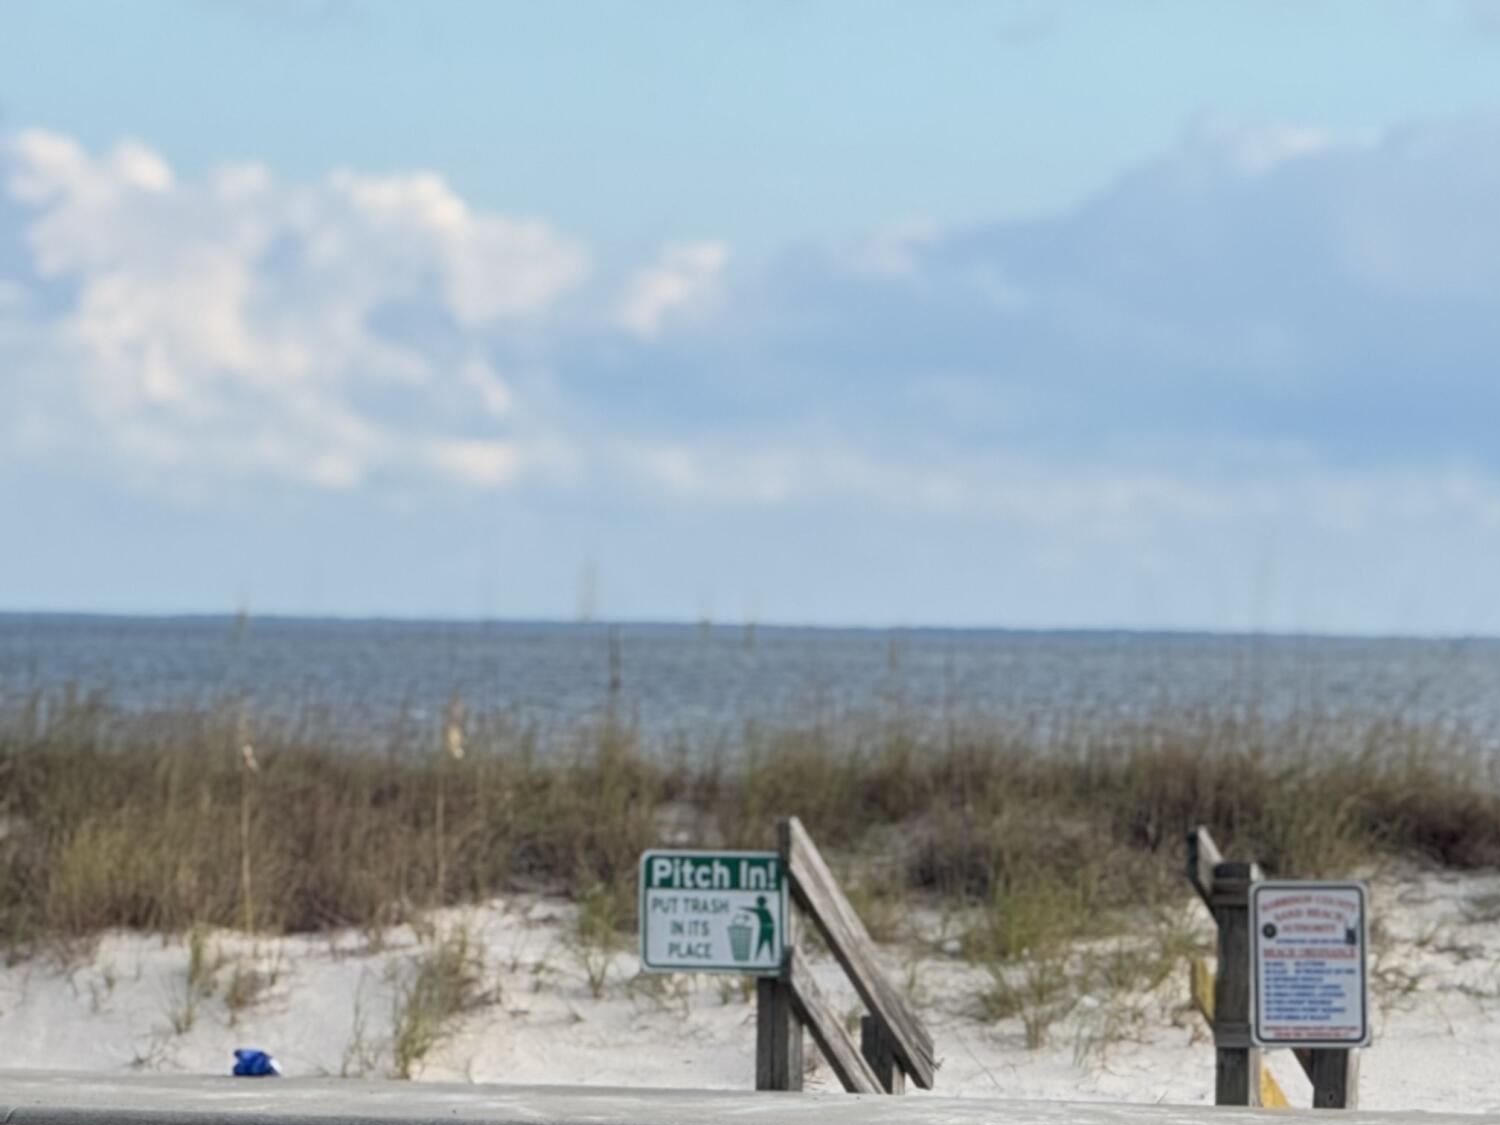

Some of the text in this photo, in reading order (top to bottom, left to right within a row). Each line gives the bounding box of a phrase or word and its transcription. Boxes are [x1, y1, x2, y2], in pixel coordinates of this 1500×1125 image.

[652, 858, 777, 889] Pitch In!
[652, 897, 730, 914] PUT TRASH
[671, 920, 709, 936] IN ITS
[668, 943, 712, 959] PLACE
